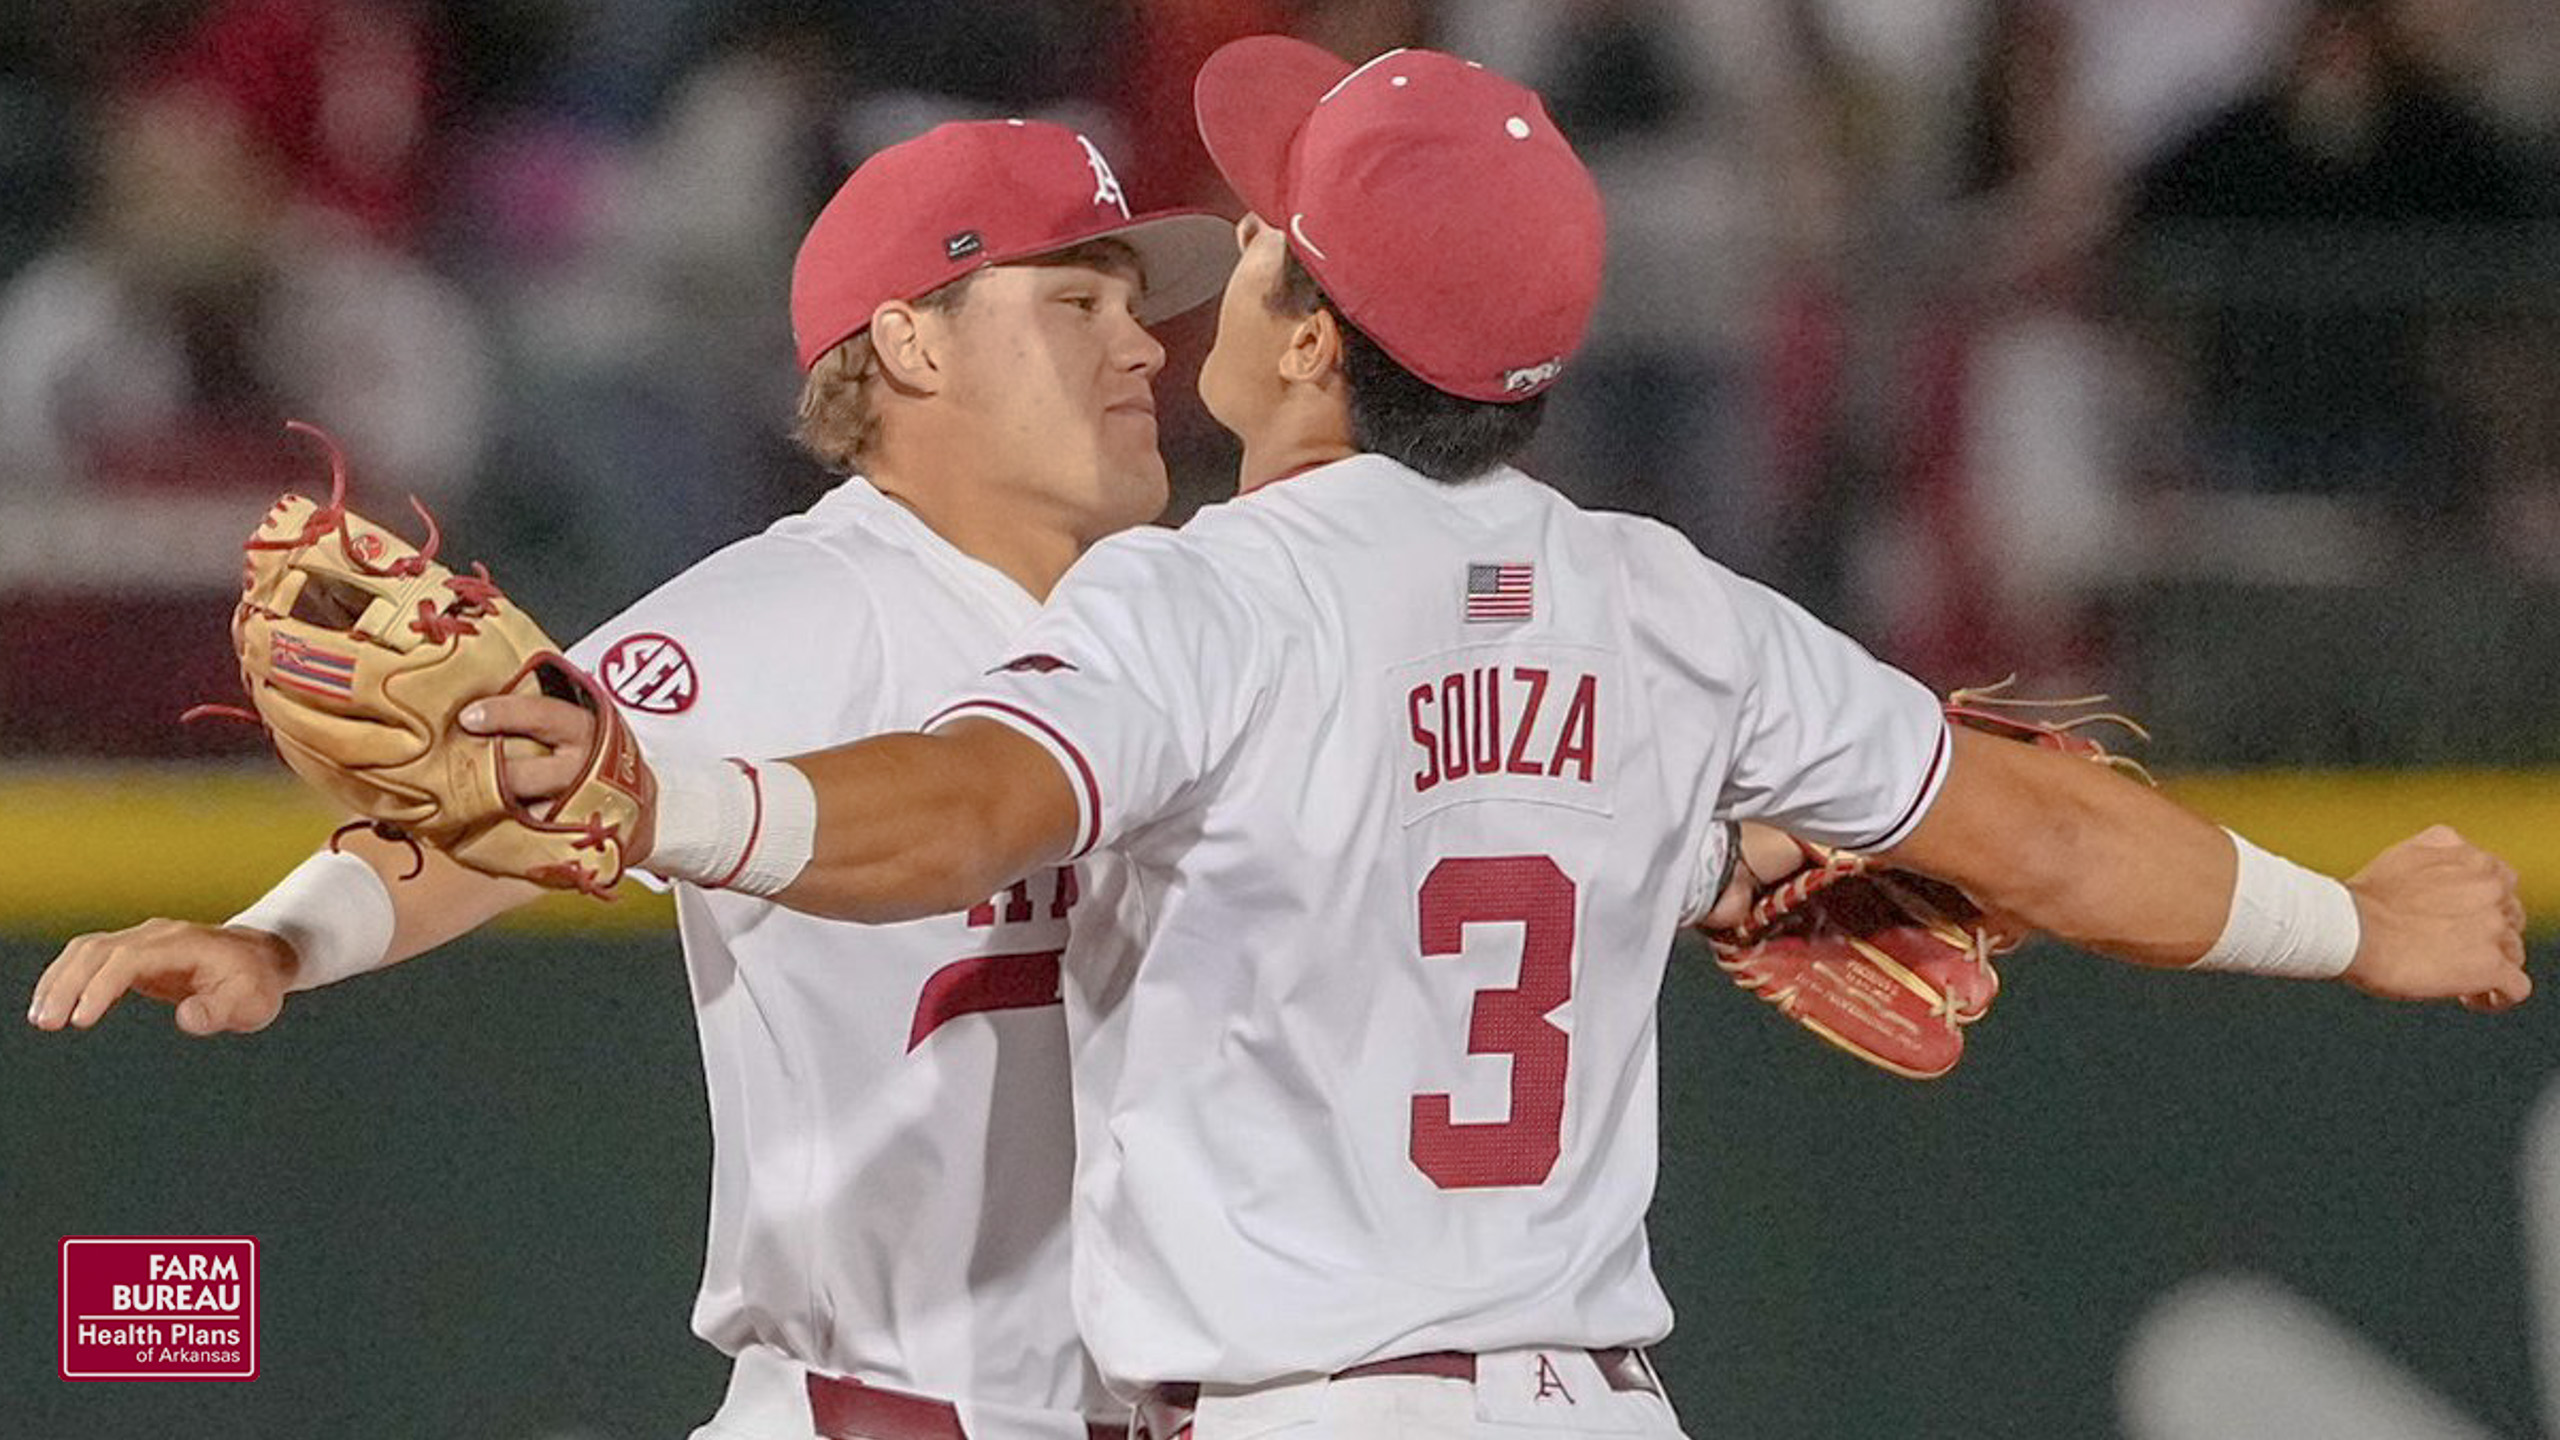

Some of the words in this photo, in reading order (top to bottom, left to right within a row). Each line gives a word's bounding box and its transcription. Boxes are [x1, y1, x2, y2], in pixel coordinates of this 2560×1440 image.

[606, 640, 692, 709] SEC
[1408, 666, 1598, 793] SOUZA
[1408, 855, 1577, 1190] 3
[1534, 1353, 1576, 1405] A
